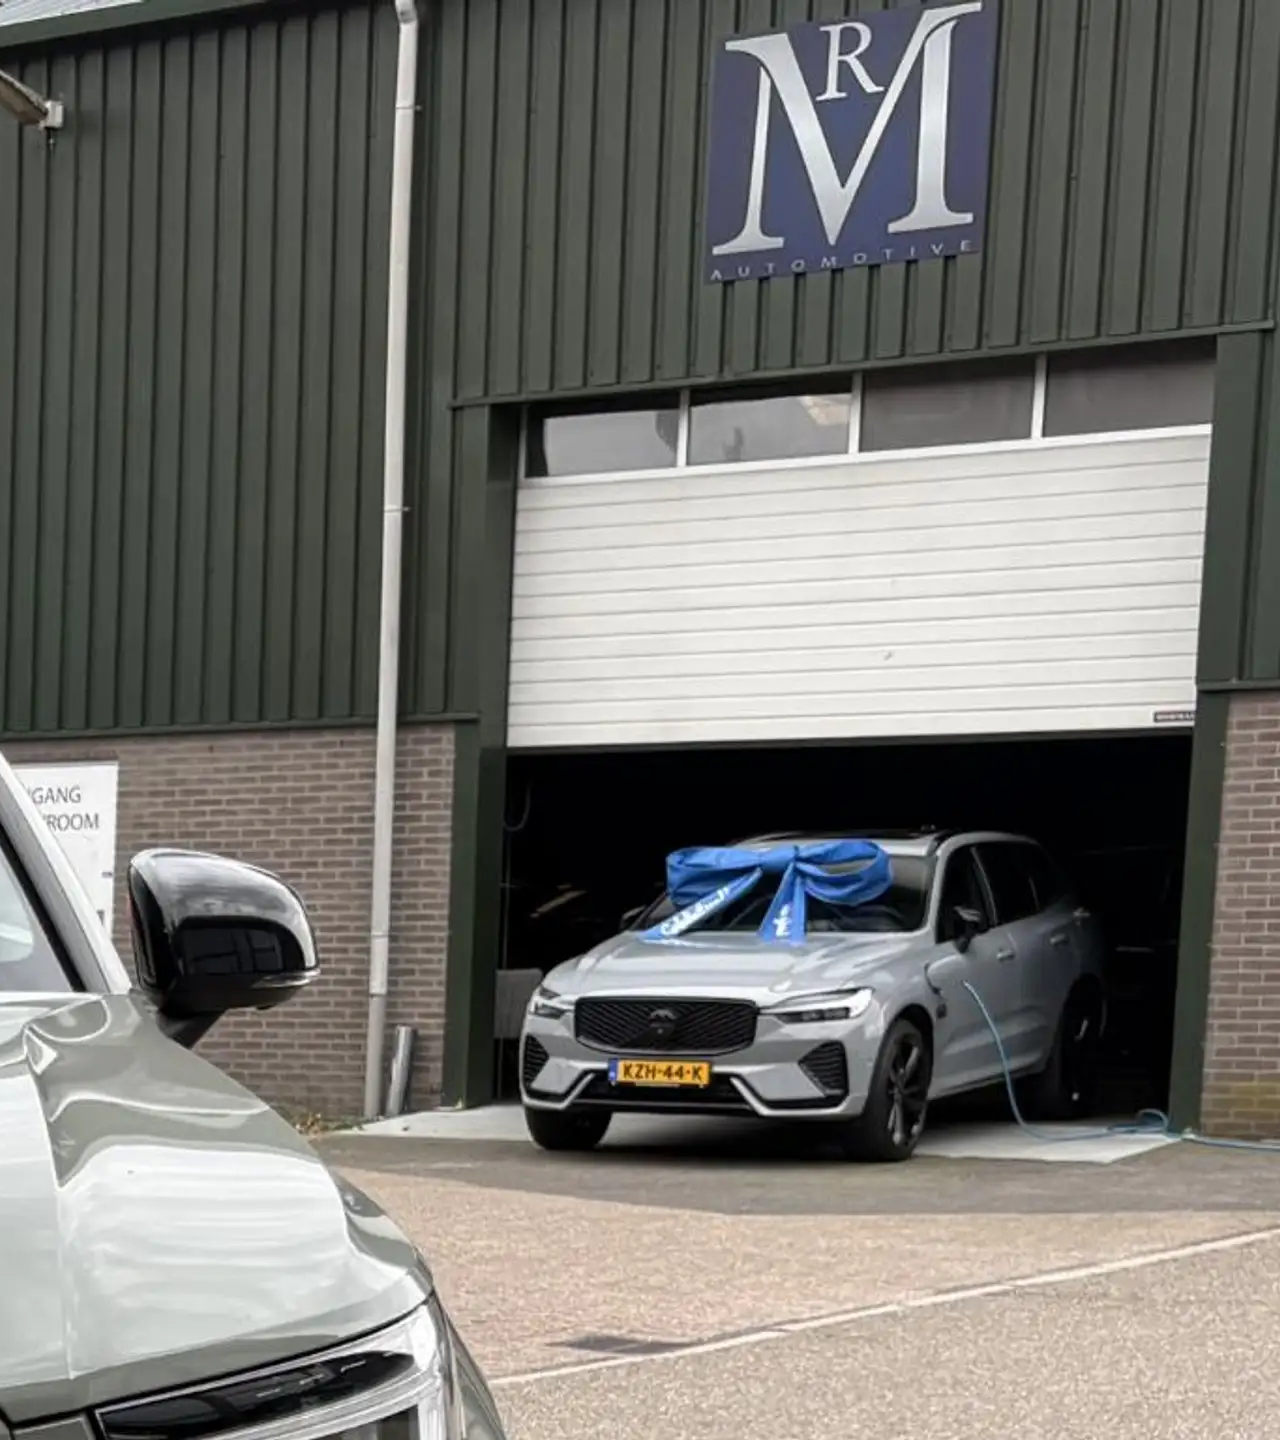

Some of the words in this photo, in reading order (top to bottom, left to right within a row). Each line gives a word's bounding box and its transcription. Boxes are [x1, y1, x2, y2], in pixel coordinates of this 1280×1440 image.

[710, 239, 975, 282] AUTOMOTIVE
[26, 785, 81, 805] GANG
[42, 813, 99, 831] ROOM
[623, 1063, 702, 1082] KZH-44-K
